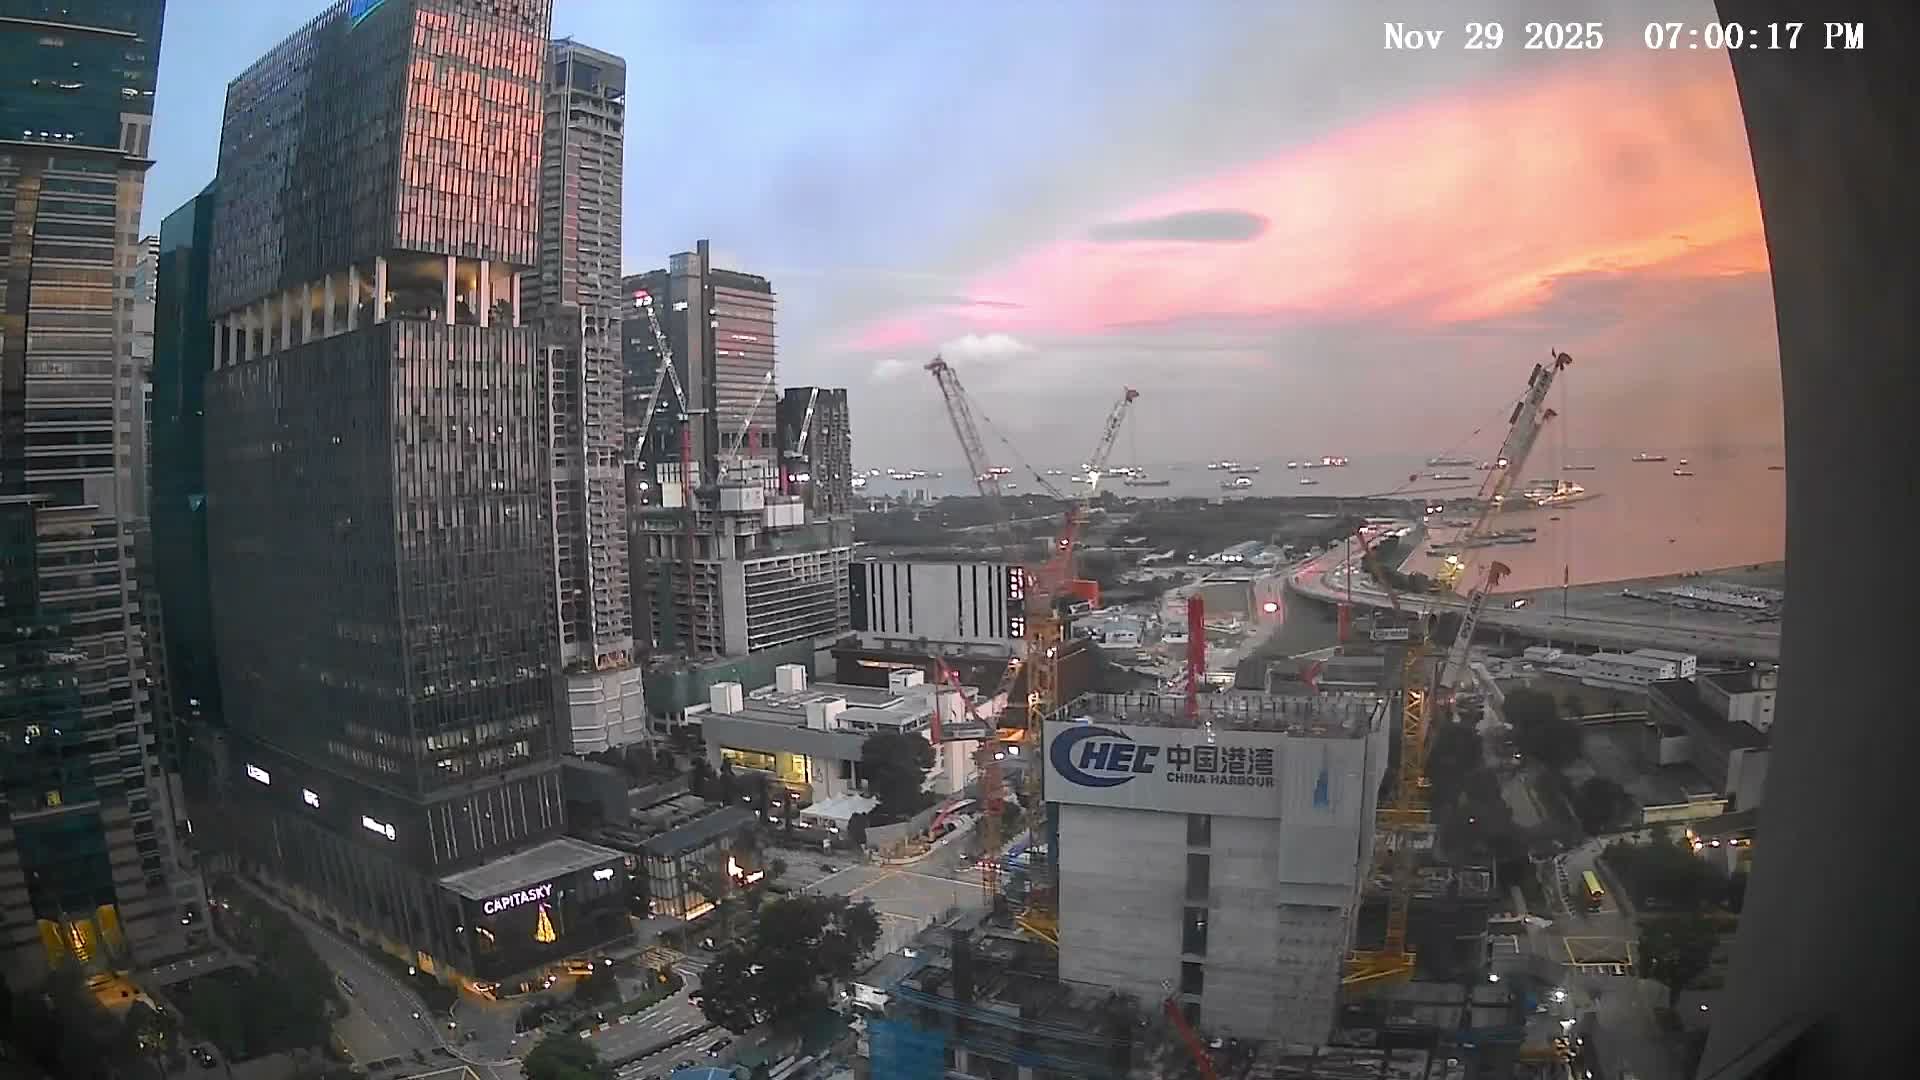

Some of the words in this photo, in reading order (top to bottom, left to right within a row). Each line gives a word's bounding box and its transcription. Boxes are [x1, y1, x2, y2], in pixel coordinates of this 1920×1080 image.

[1166, 743, 1275, 776] 中国港湾
[1166, 771, 1207, 784] CHINA
[1210, 774, 1276, 788] HARBOUR
[483, 883, 553, 914] CAPITASKY
